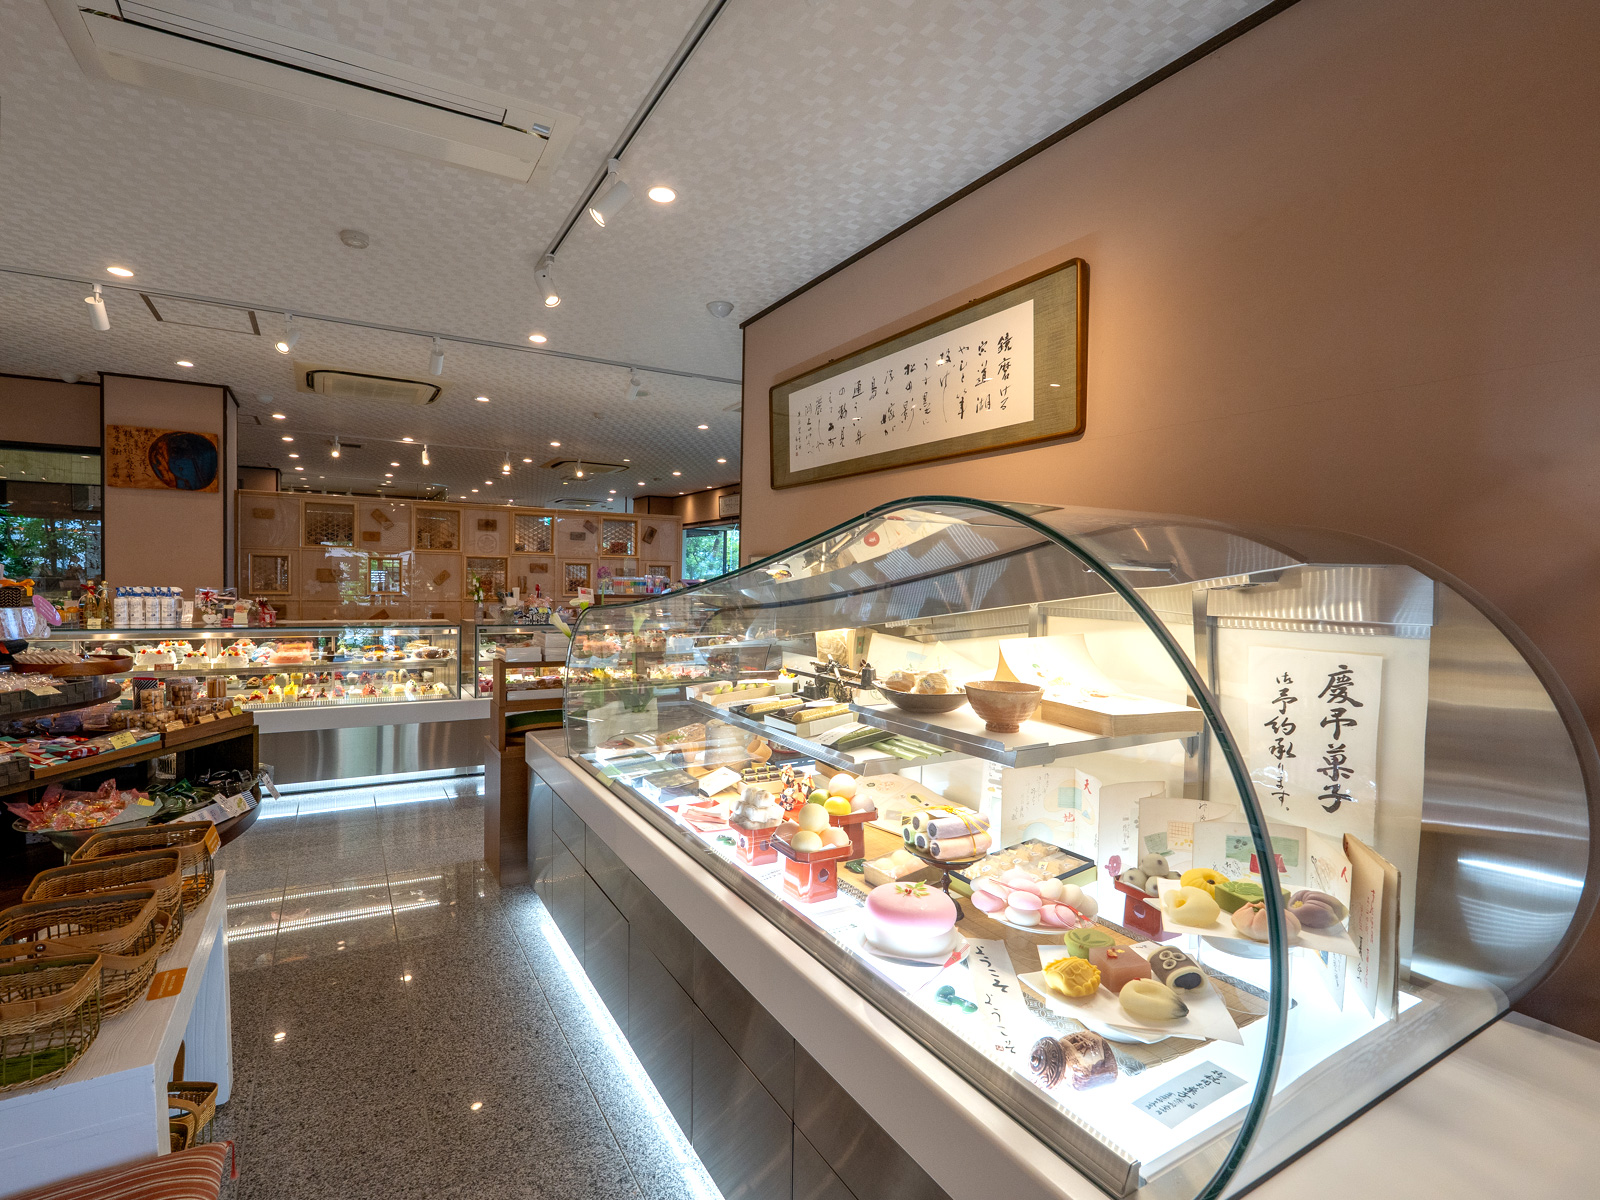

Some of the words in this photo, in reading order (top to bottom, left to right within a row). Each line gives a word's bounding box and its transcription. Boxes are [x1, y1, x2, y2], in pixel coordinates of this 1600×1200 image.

[1316, 665, 1363, 813] 慶弔菓子
[1083, 778, 1092, 794] 天
[1063, 812, 1076, 823] 地
